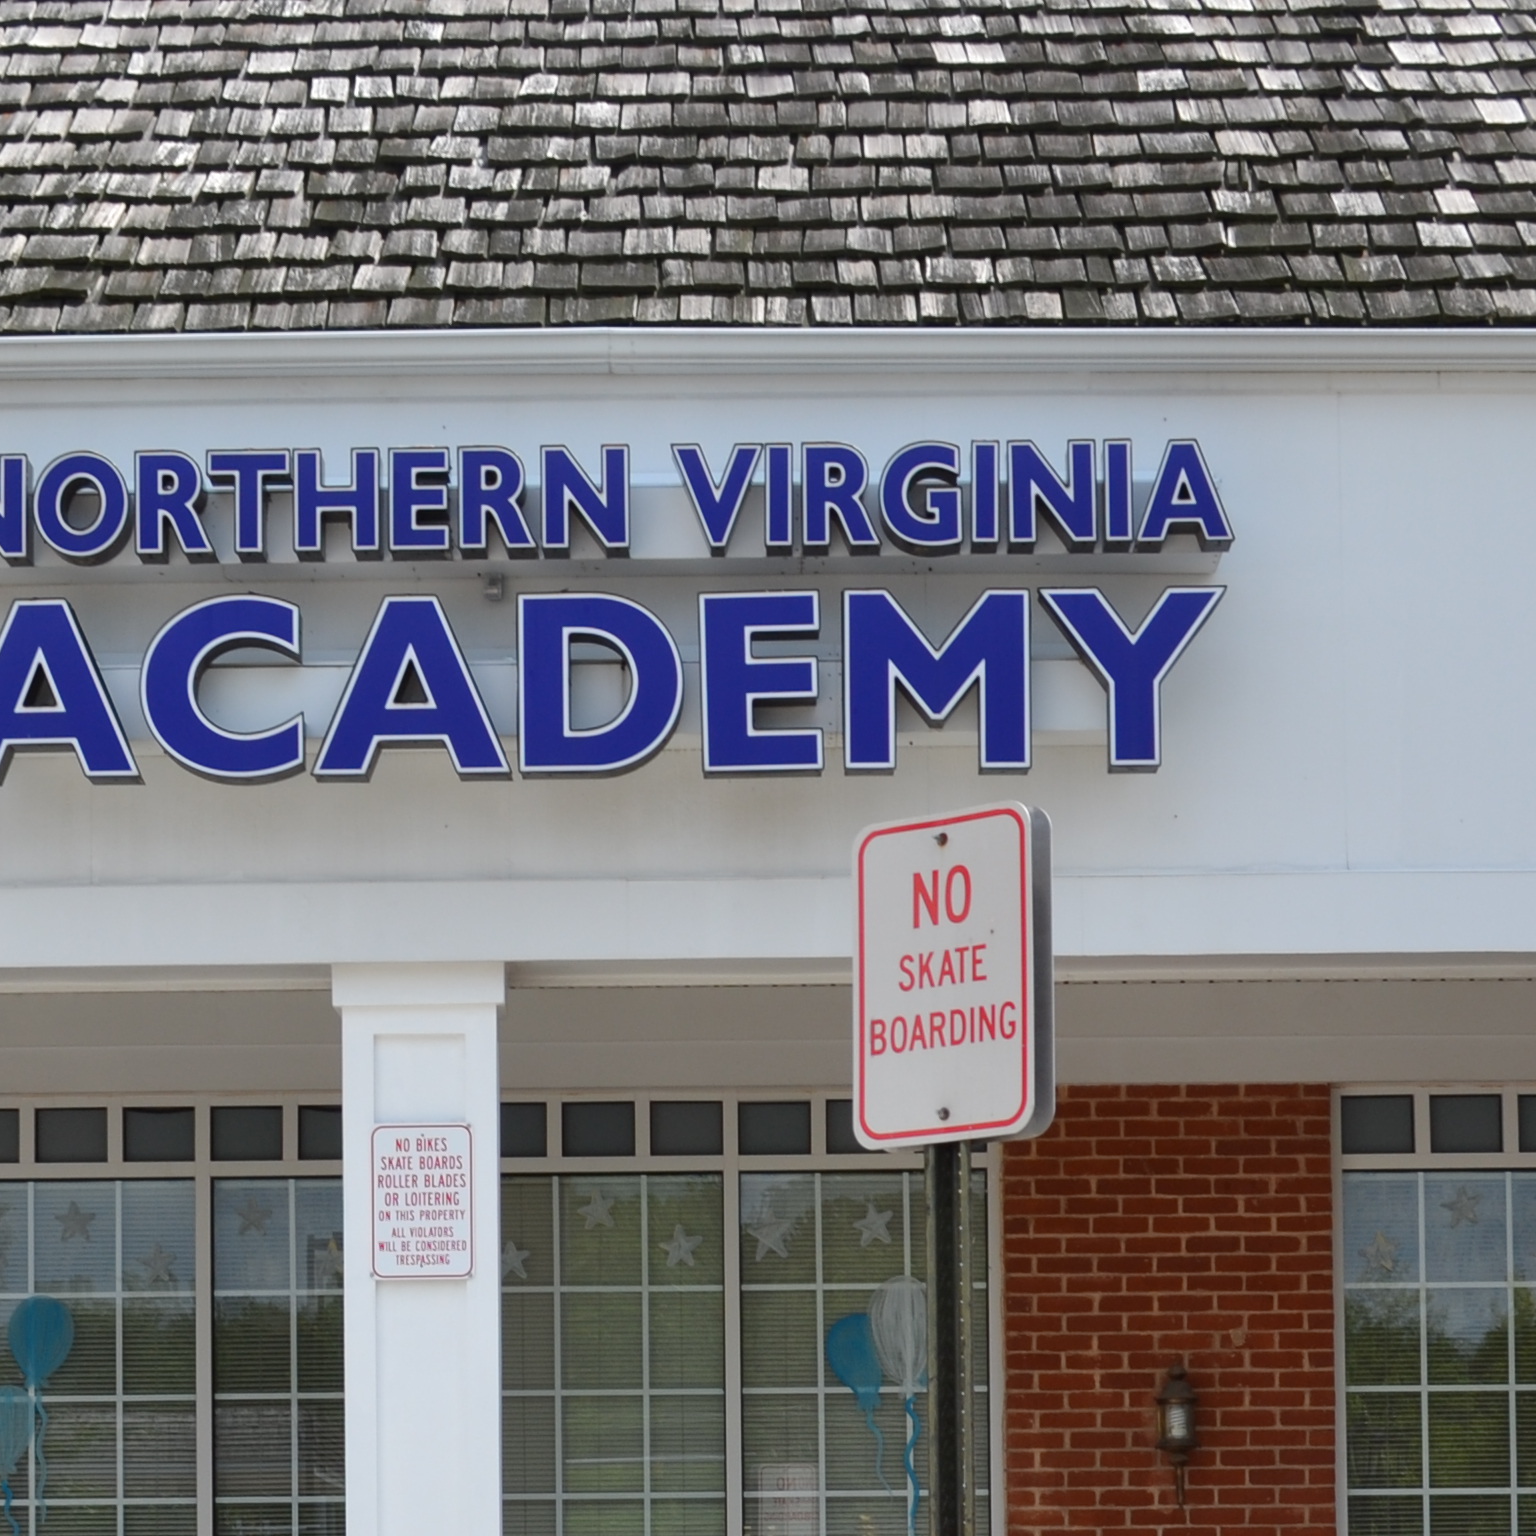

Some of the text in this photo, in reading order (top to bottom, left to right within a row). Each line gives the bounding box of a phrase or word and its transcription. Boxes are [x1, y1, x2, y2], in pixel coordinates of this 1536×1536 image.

[671, 438, 1236, 553] VIRGINIA
[912, 864, 972, 929] NO
[898, 943, 988, 992] SKATE
[870, 1001, 1017, 1056] BOARDING
[395, 1137, 448, 1152] NO BIKES
[380, 1155, 463, 1171] SKATE BOARDS
[377, 1173, 467, 1189] ROLLER BLADES
[384, 1191, 460, 1207] OR LOITERING
[378, 1209, 466, 1221] ON THIS PROPERTY
[391, 1226, 454, 1238] ALL VIOLATORS
[378, 1240, 467, 1252] WILL BE CONSIDERED
[396, 1254, 451, 1266] TRESPASSING
